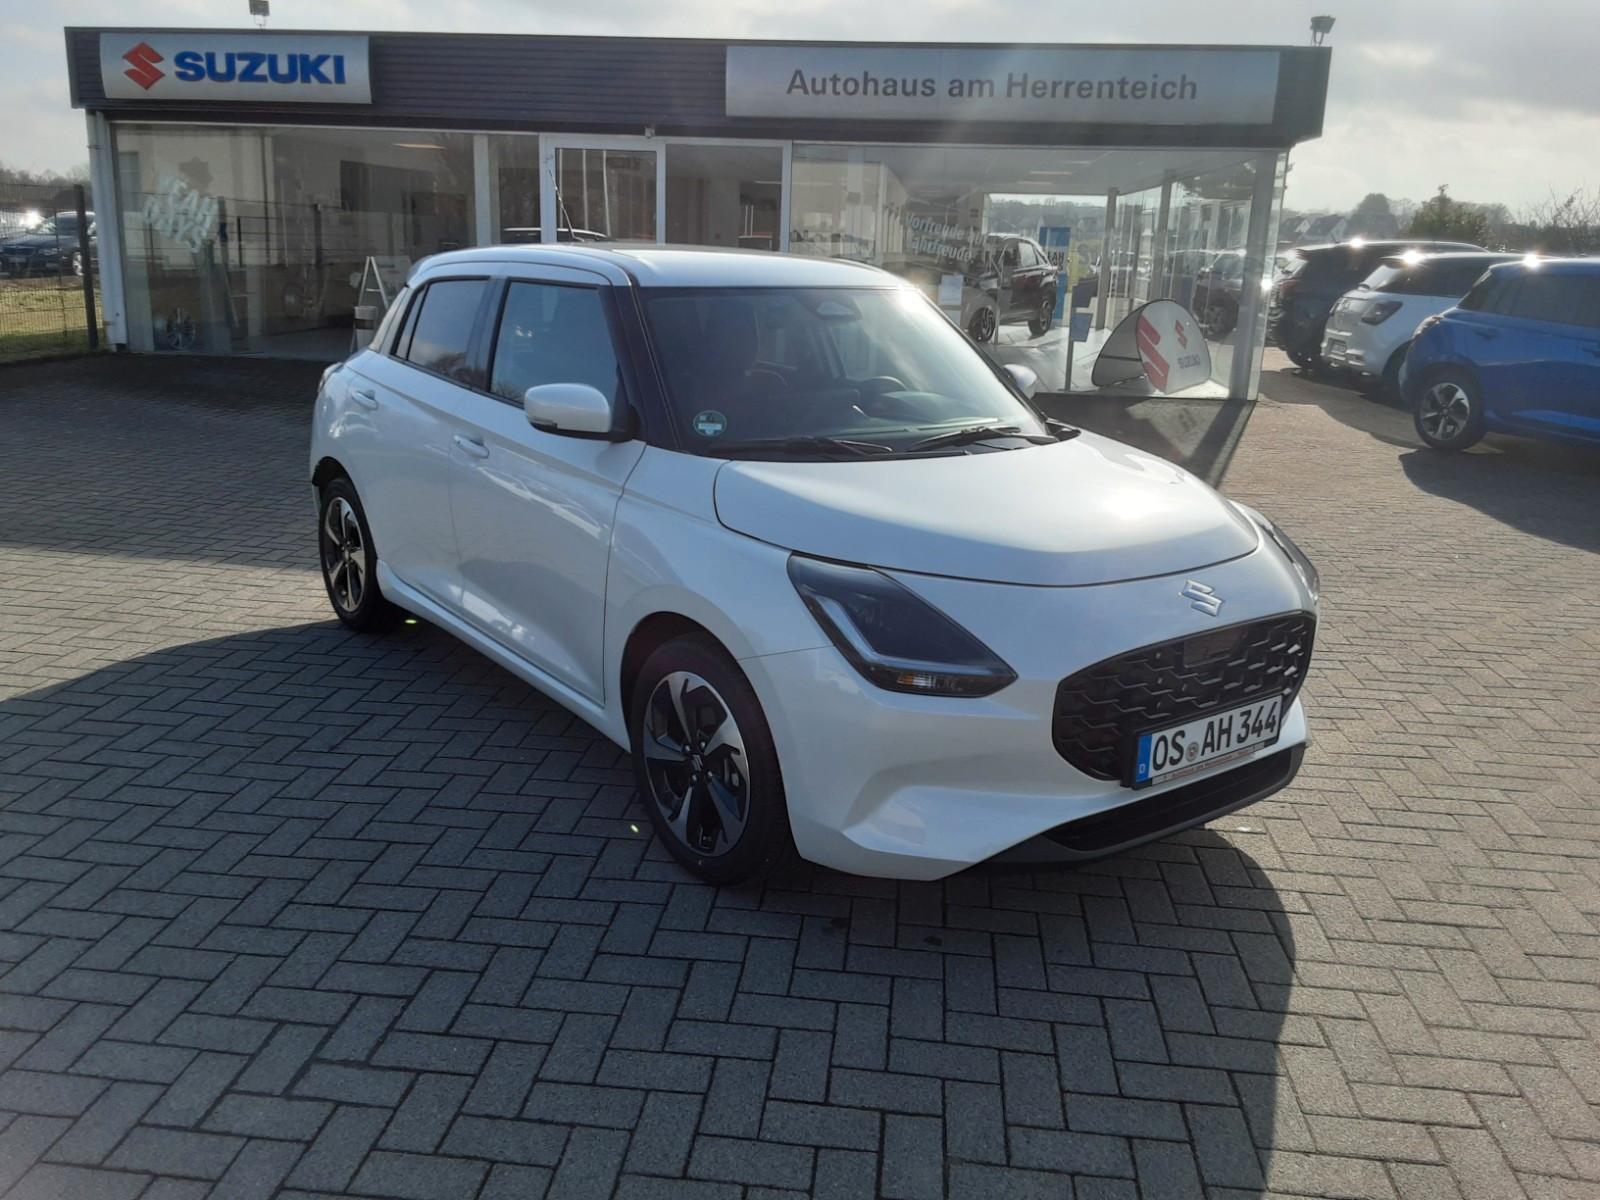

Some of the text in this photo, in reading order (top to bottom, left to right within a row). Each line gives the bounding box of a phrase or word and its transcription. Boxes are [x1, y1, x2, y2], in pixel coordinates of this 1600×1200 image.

[174, 51, 346, 84] SUZUKI
[786, 69, 1197, 99] Autohaus am Herrenteich
[905, 212, 965, 241] Vorfreude
[1152, 730, 1186, 771] OS
[1201, 715, 1233, 757] AH
[1236, 701, 1279, 744] 344
